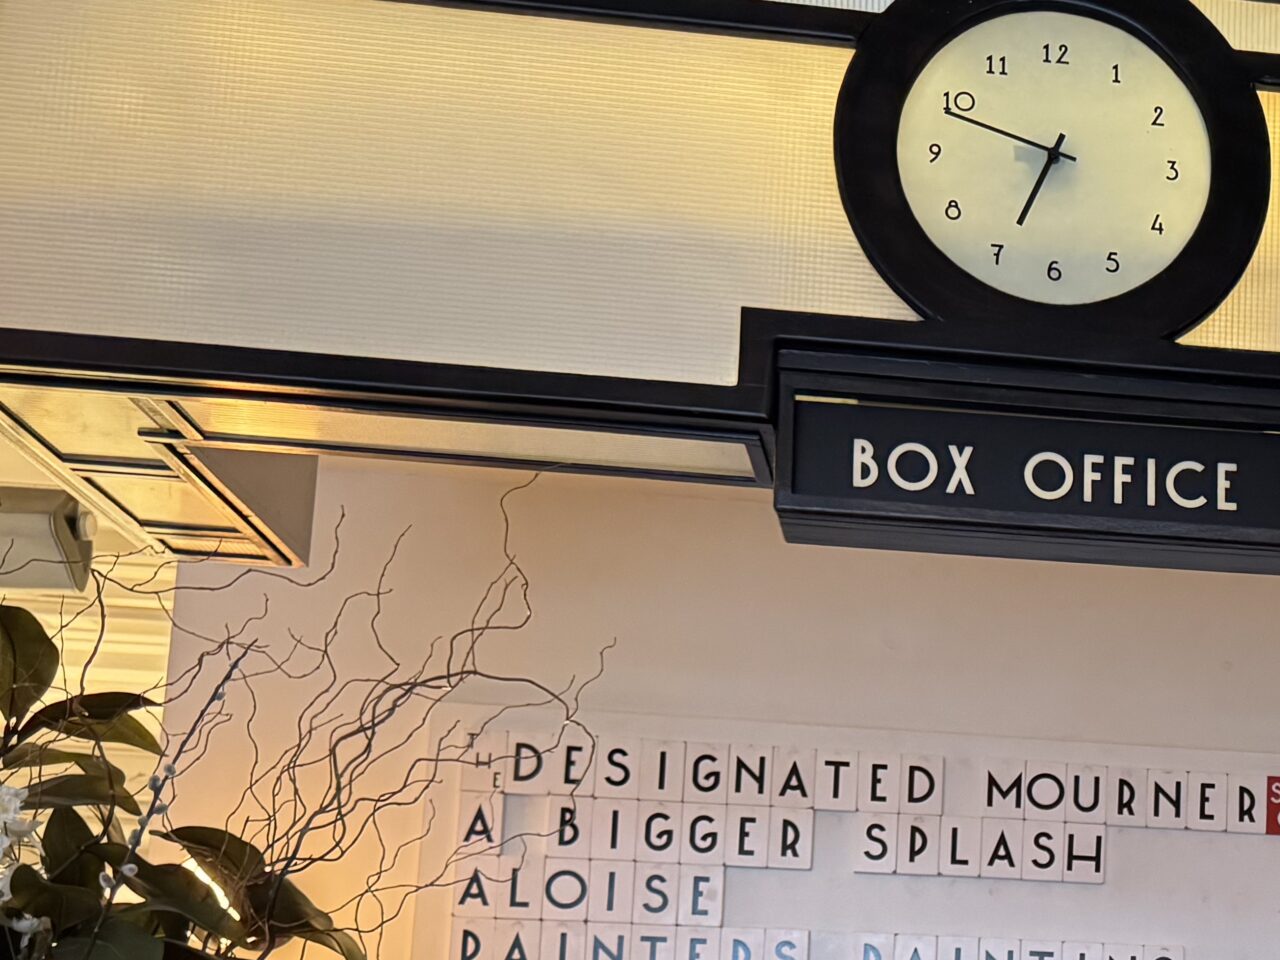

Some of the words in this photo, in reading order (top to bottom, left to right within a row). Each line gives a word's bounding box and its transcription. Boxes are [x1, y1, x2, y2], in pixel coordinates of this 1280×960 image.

[1042, 43, 1070, 65] 12
[985, 55, 1009, 76] 11
[1111, 64, 1121, 84] 1
[943, 91, 976, 112] 10
[1150, 106, 1165, 126] 2
[928, 143, 942, 163] 9
[1165, 160, 1180, 181] 3
[944, 199, 962, 220] 8
[1150, 214, 1165, 235] 4
[990, 244, 1004, 266] 7
[1105, 252, 1120, 273] 5
[1046, 261, 1062, 282] 6
[852, 438, 976, 495] BOX
[1024, 451, 1239, 511] OFFICE
[467, 733, 501, 788] THE
[513, 742, 936, 803] DESIGNATED
[987, 769, 1256, 824] MOURNER
[463, 804, 494, 843] A
[557, 807, 801, 857] BIGGER
[863, 823, 1102, 873] SPLASH
[458, 868, 711, 916] ALOISE
